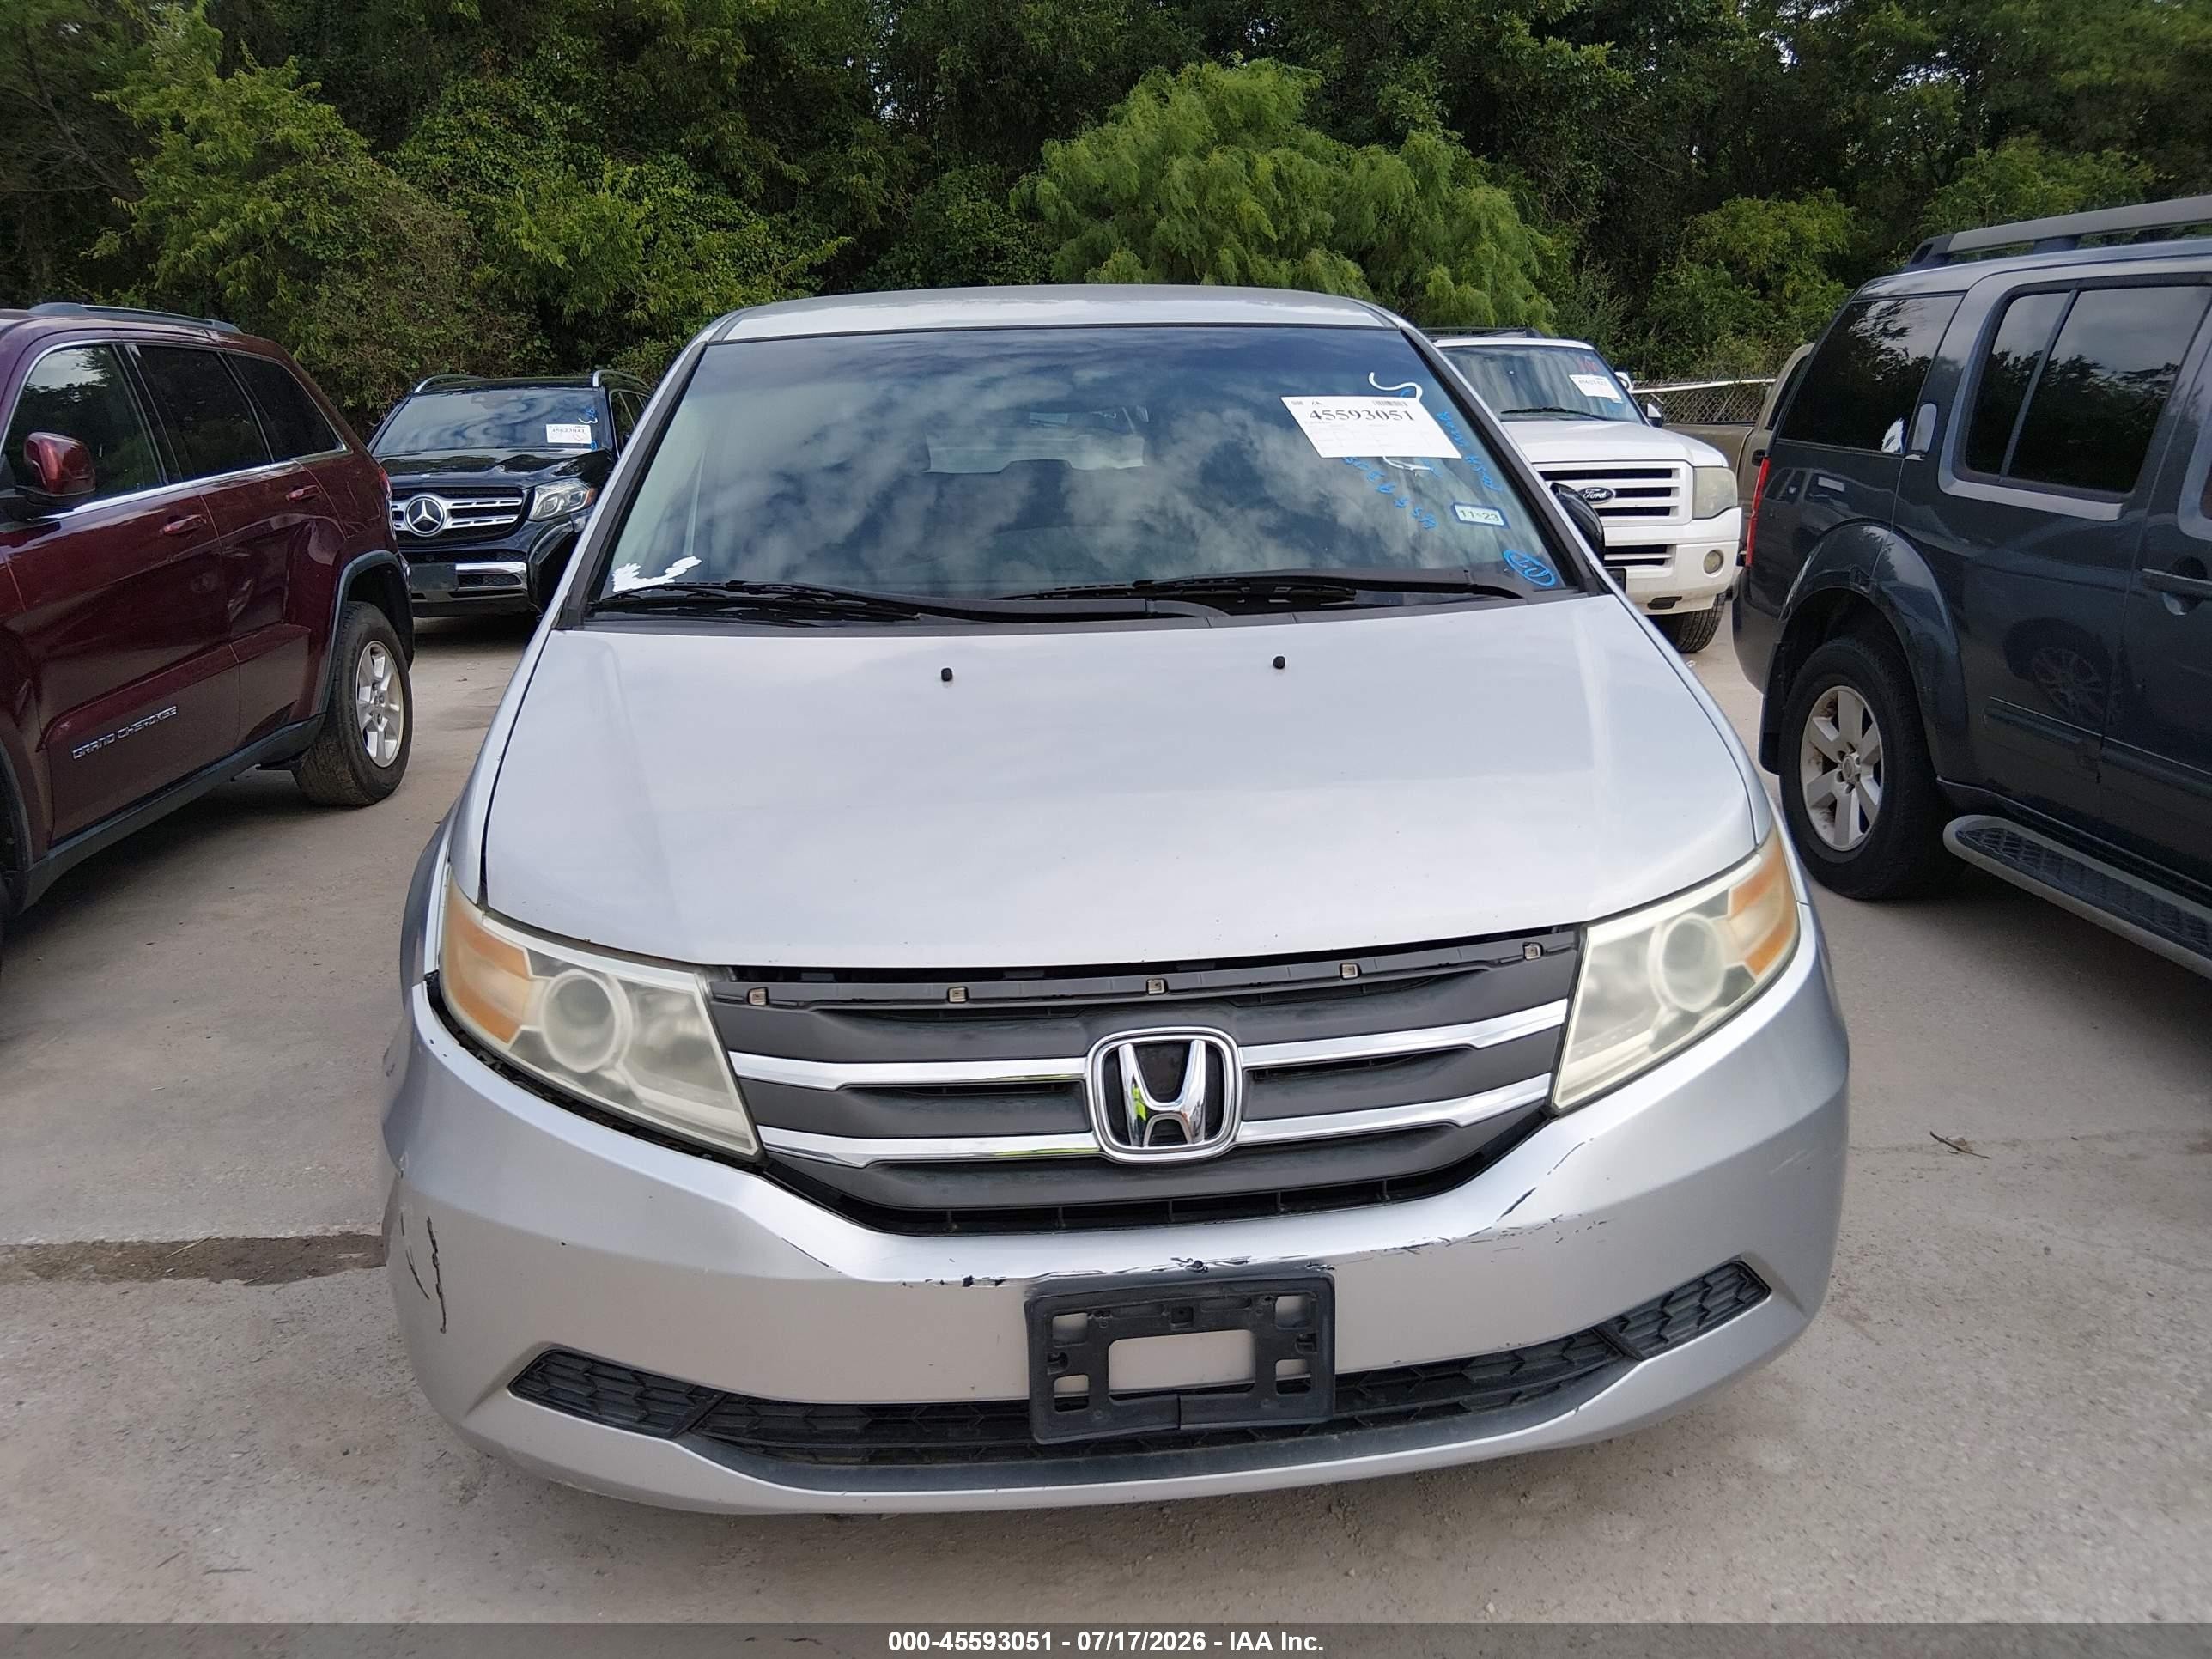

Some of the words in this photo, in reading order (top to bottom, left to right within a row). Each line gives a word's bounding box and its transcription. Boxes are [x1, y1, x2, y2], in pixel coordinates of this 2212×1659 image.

[1309, 409, 1415, 422] 45593051
[1583, 489, 1607, 499] Ford
[1459, 509, 1500, 522] 11-23
[72, 733, 115, 759] GRAND
[117, 706, 178, 738] CHEROKEE
